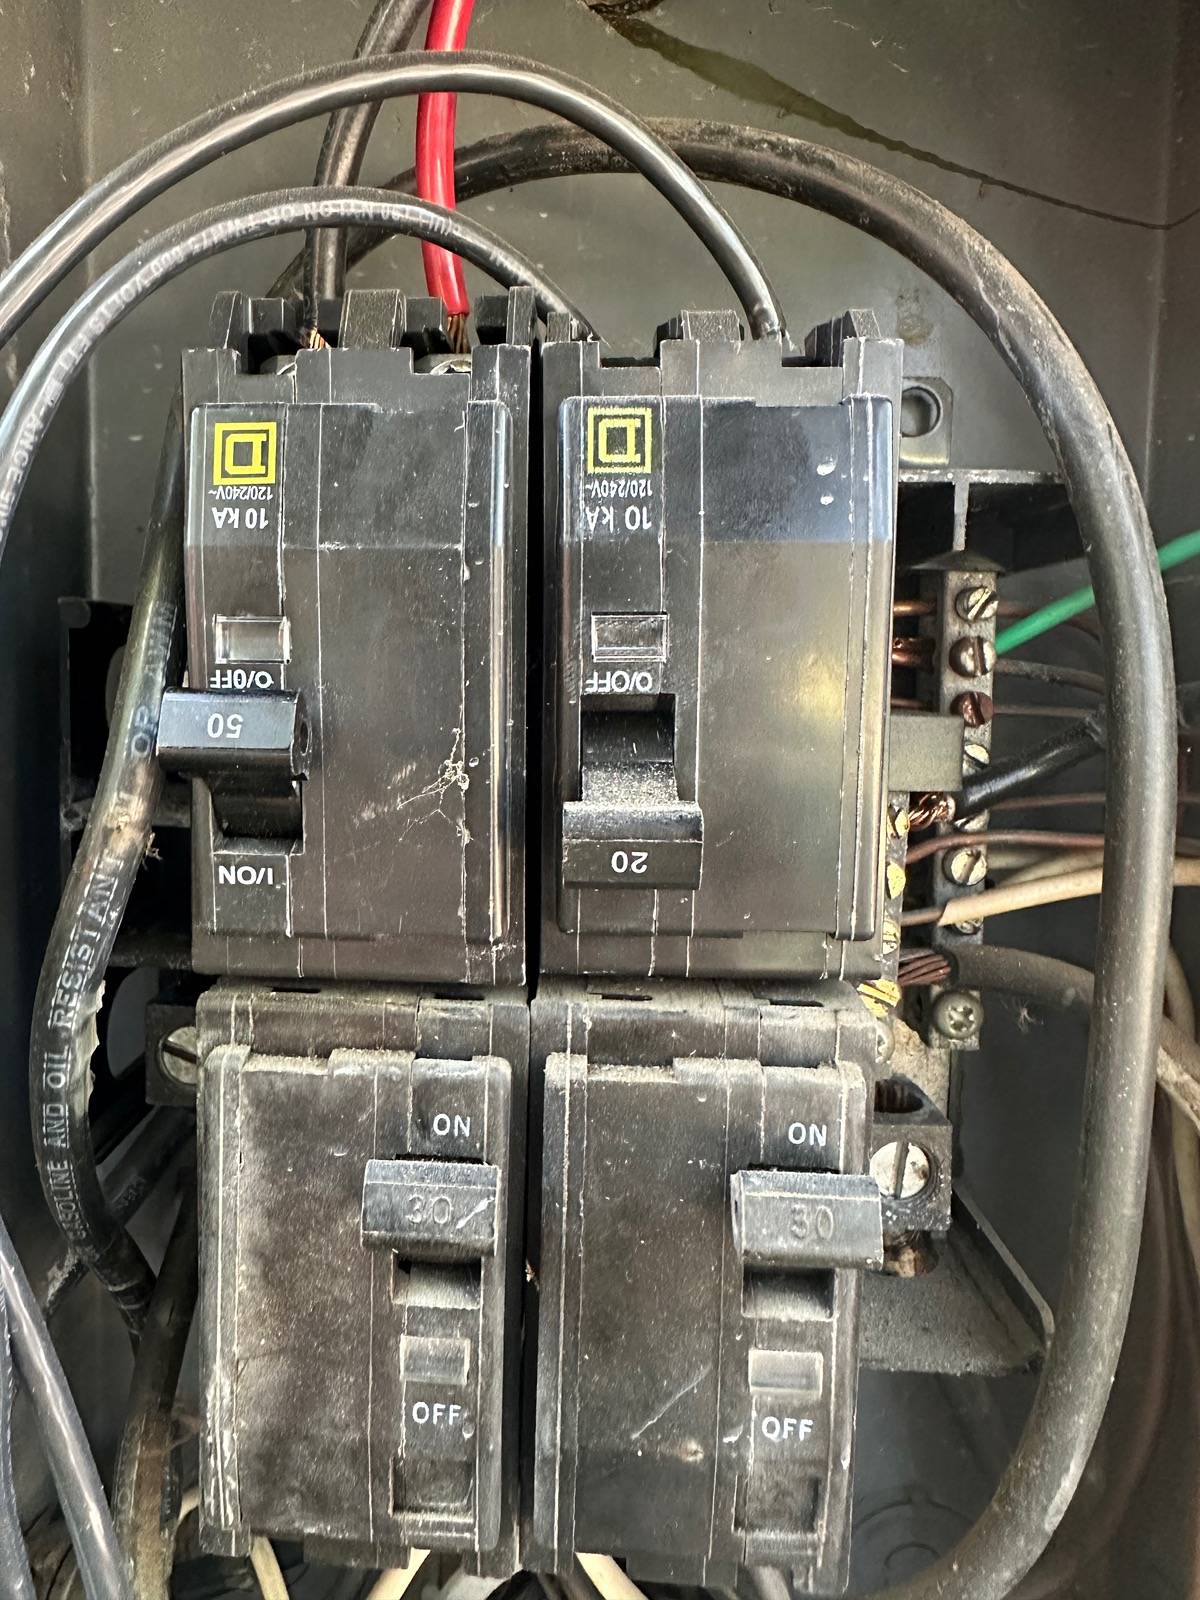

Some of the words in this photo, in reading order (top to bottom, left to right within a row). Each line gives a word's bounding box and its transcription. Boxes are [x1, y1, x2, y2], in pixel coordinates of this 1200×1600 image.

[211, 507, 240, 529] kA
[245, 507, 269, 529] 10
[585, 506, 614, 533] kA
[624, 505, 652, 531] 10
[585, 670, 652, 692] O/OFF
[207, 713, 243, 739] 50
[218, 864, 274, 885] I/ON
[611, 850, 648, 874] 20
[53, 847, 123, 1028] RESISTANT
[47, 1047, 70, 1090] OIL
[46, 1103, 69, 1148] AND
[433, 1113, 471, 1137] ON
[788, 1121, 828, 1147] ON
[48, 1158, 87, 1241] GASOLINE
[407, 1194, 453, 1224] 30
[790, 1204, 834, 1239] 30
[411, 1400, 462, 1426] OFF
[761, 1415, 814, 1440] OFF
